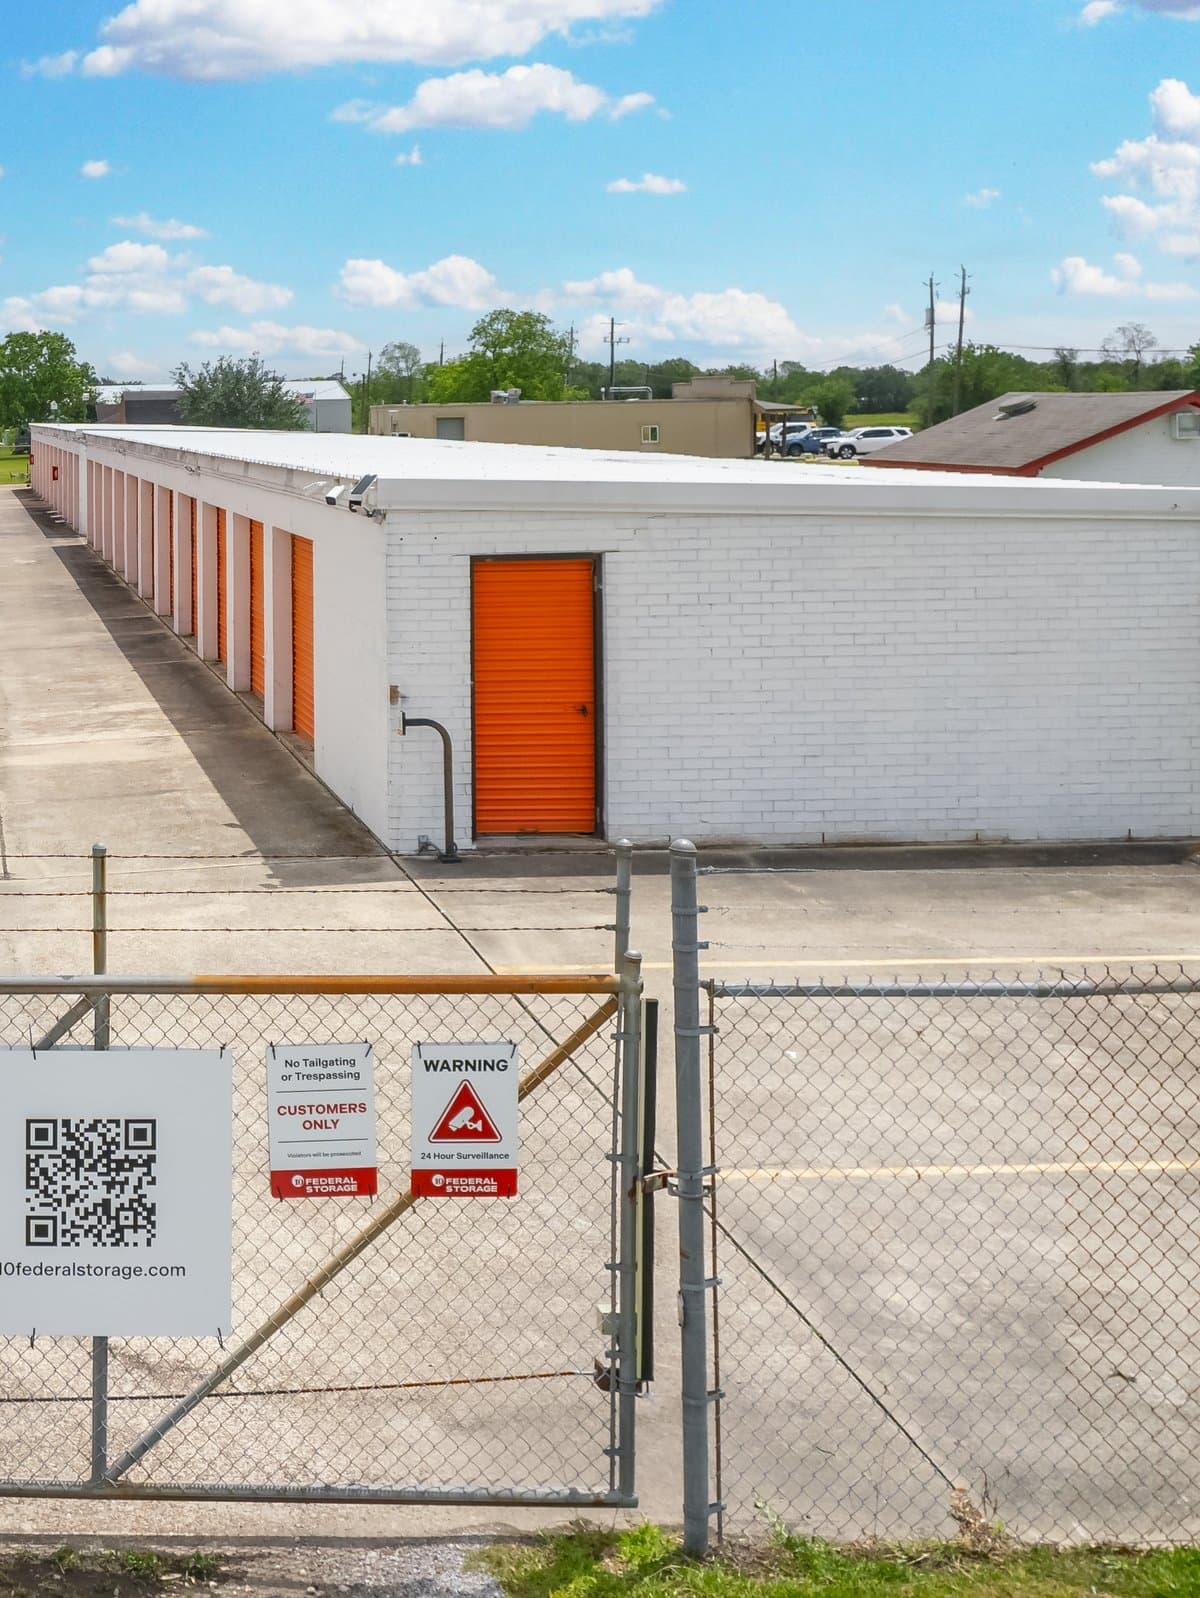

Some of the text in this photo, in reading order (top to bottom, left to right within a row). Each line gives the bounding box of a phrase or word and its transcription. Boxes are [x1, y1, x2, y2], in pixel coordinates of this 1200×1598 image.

[284, 1057, 356, 1069] No Tailgating
[423, 1059, 509, 1072] WARNING
[281, 1070, 361, 1082] or Trespassing
[277, 1102, 367, 1116] CUSTOMERS
[302, 1119, 340, 1130] ONLY
[420, 1152, 510, 1160] 24 Hour Surveillance
[305, 1176, 358, 1186] FEDERAL
[445, 1177, 498, 1185] FEDERAL
[305, 1184, 358, 1193] STORAGE
[445, 1185, 498, 1193] STORAGE
